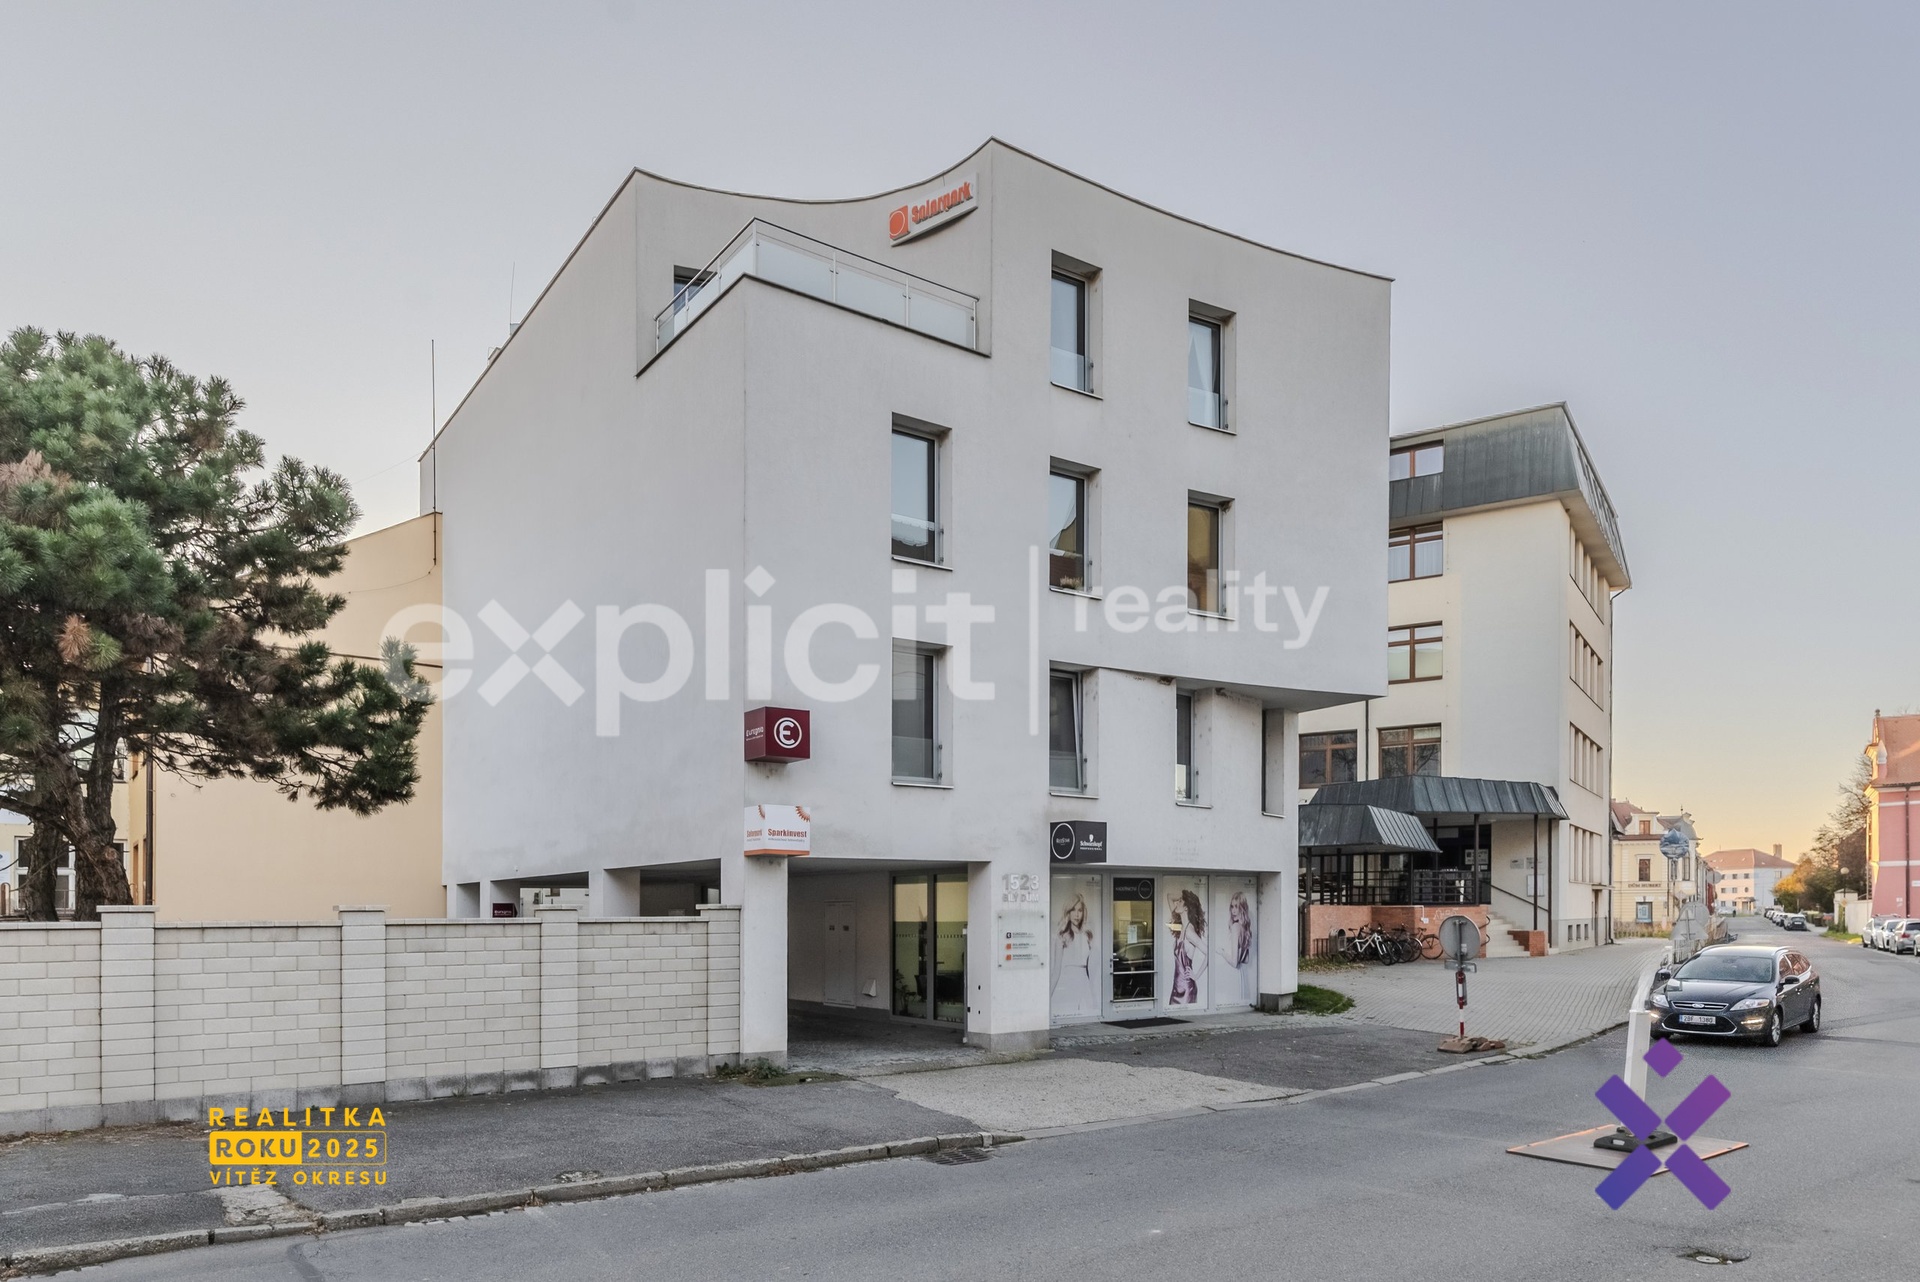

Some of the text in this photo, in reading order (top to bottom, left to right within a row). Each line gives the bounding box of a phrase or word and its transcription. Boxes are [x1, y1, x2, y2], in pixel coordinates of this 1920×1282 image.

[911, 181, 972, 224] Solarpark
[767, 828, 807, 838] Sparkinvest
[1001, 873, 1039, 891] 1523
